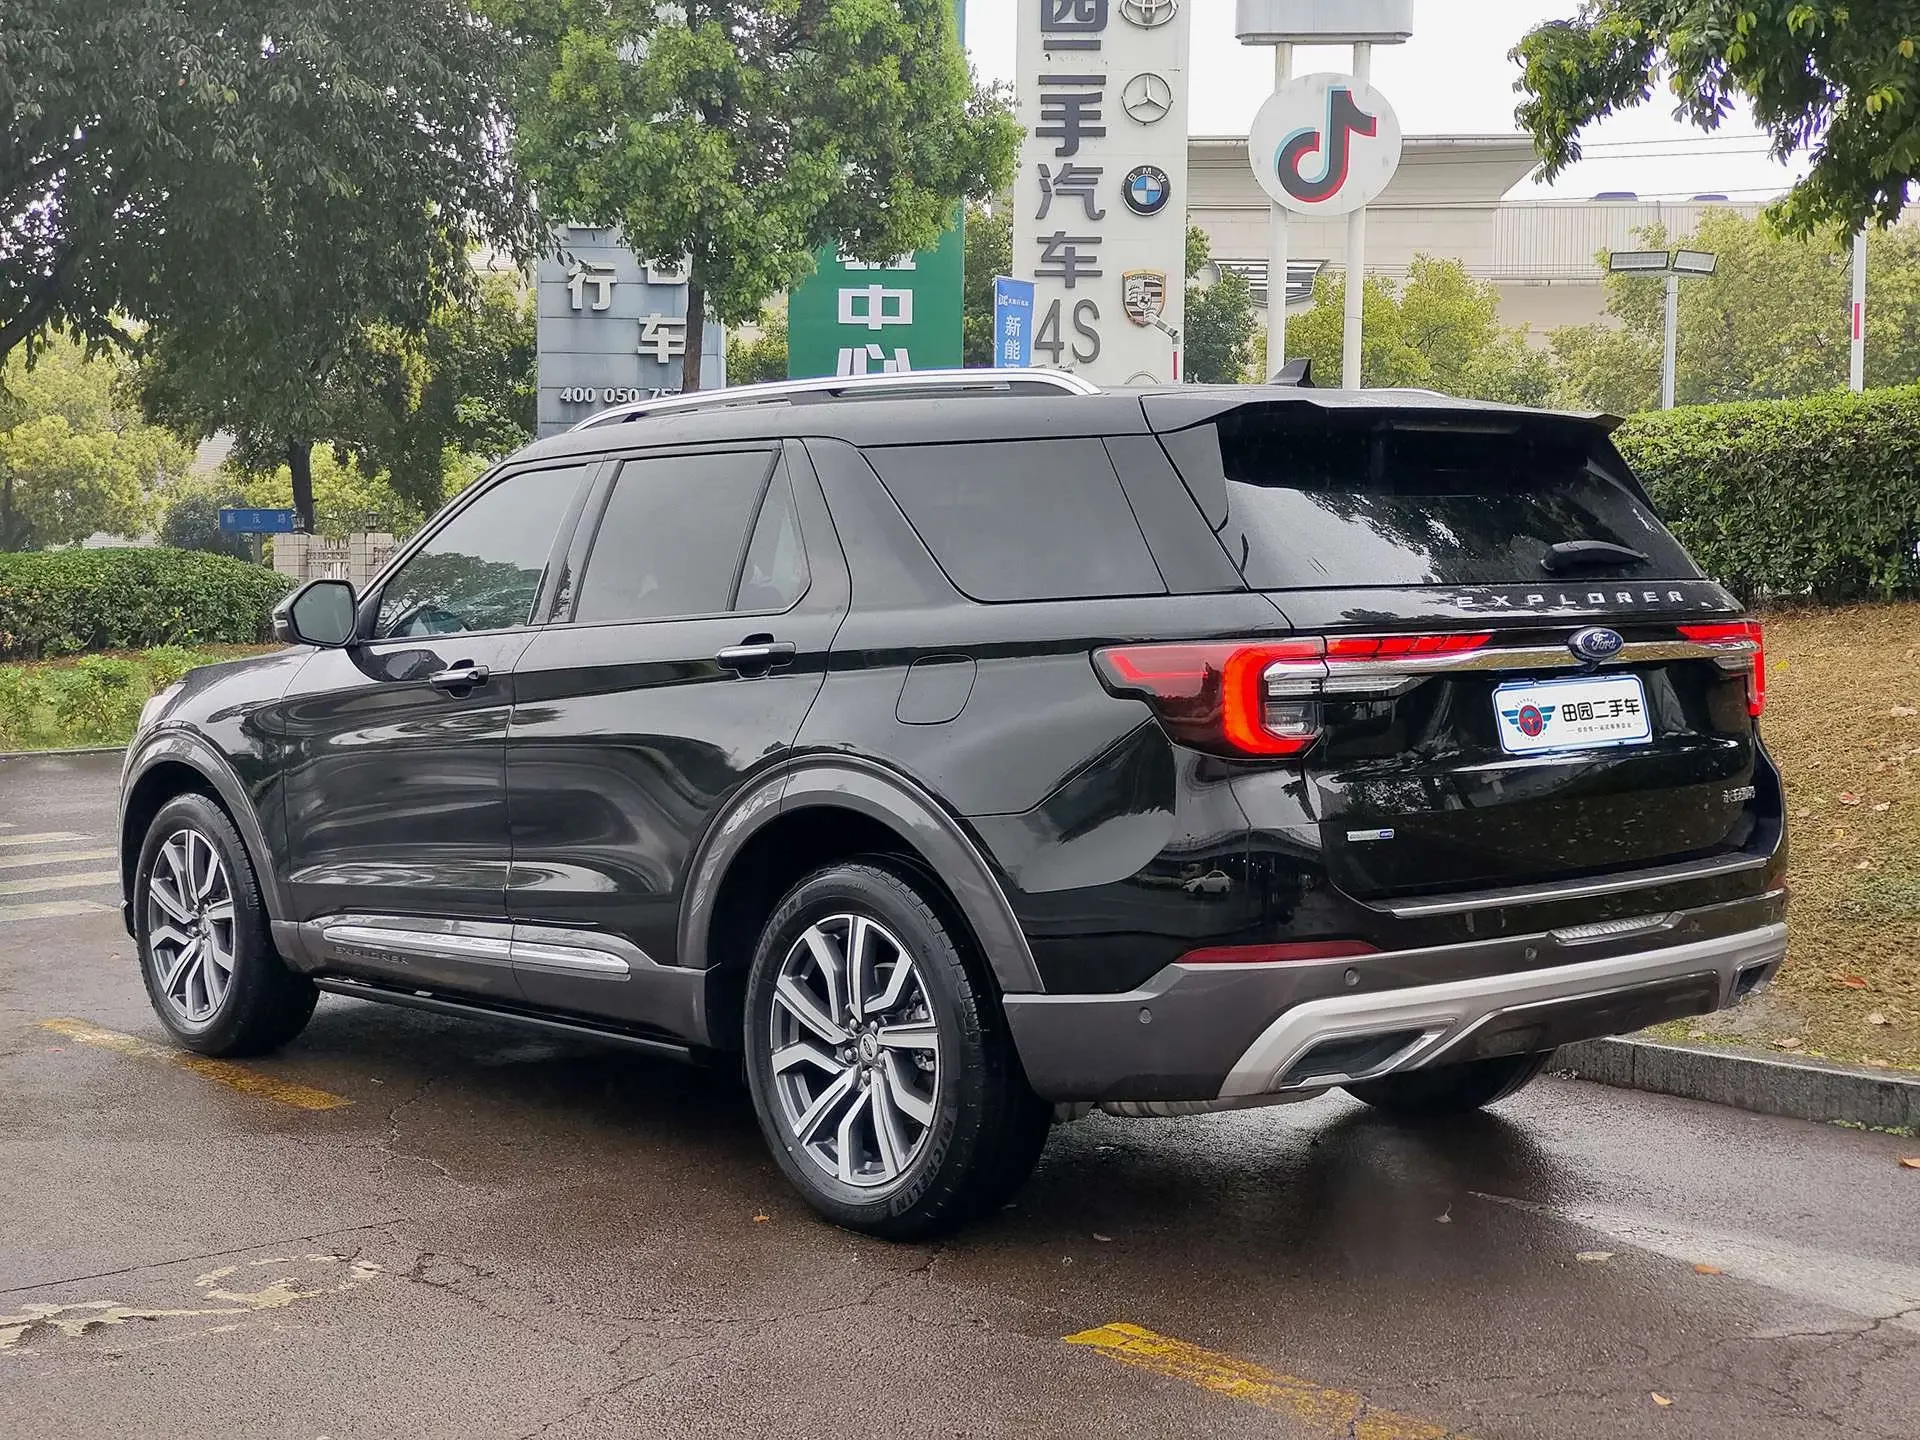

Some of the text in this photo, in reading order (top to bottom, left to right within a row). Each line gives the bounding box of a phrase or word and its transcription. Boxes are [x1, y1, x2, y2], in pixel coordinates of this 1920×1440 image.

[1127, 167, 1167, 182] BMW
[836, 248, 916, 377] 中心
[1005, 314, 1021, 368] 新能
[560, 386, 597, 402] 400
[603, 387, 640, 403] 050
[1456, 590, 1684, 608] EXPLORER
[1591, 632, 1618, 651] Ford
[1562, 698, 1641, 722] 田园二手车
[895, 1116, 955, 1213] MICHELIN
